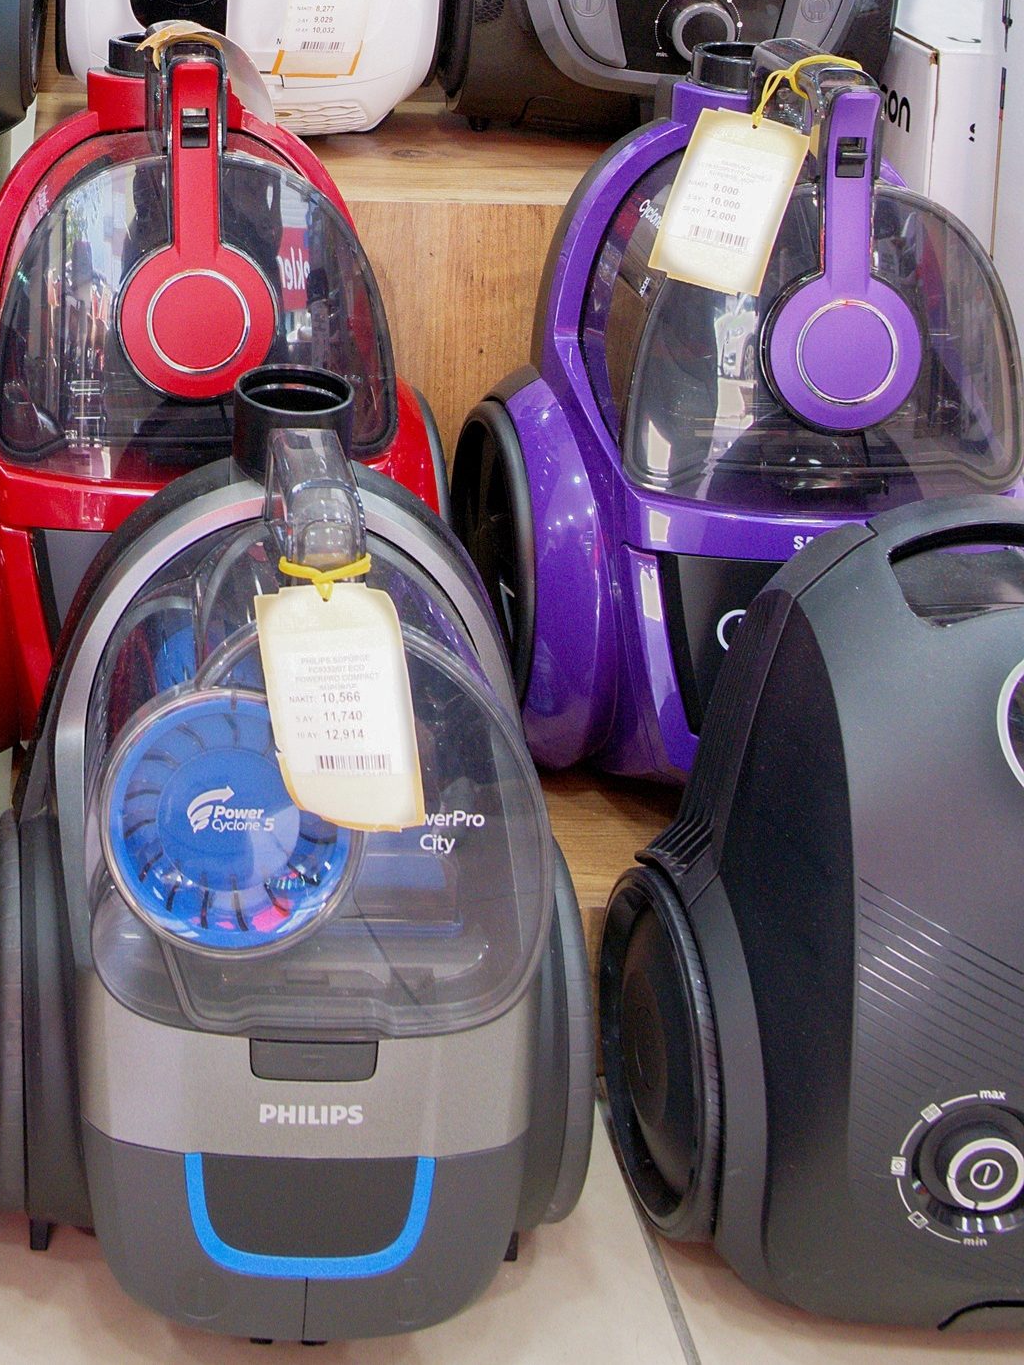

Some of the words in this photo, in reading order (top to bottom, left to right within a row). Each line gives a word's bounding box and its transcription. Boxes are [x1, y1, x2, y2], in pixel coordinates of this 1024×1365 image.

[316, 5, 335, 13] 8,277
[322, 691, 362, 704] 10,566
[323, 710, 363, 723] 11,740
[325, 729, 365, 742] 12,914
[214, 806, 265, 820] Power
[211, 818, 261, 833] Cyclone
[263, 818, 275, 833] 5
[419, 833, 456, 855] City
[979, 1089, 1007, 1101] max
[258, 1103, 364, 1127] PHILIPS
[962, 1236, 988, 1248] min
